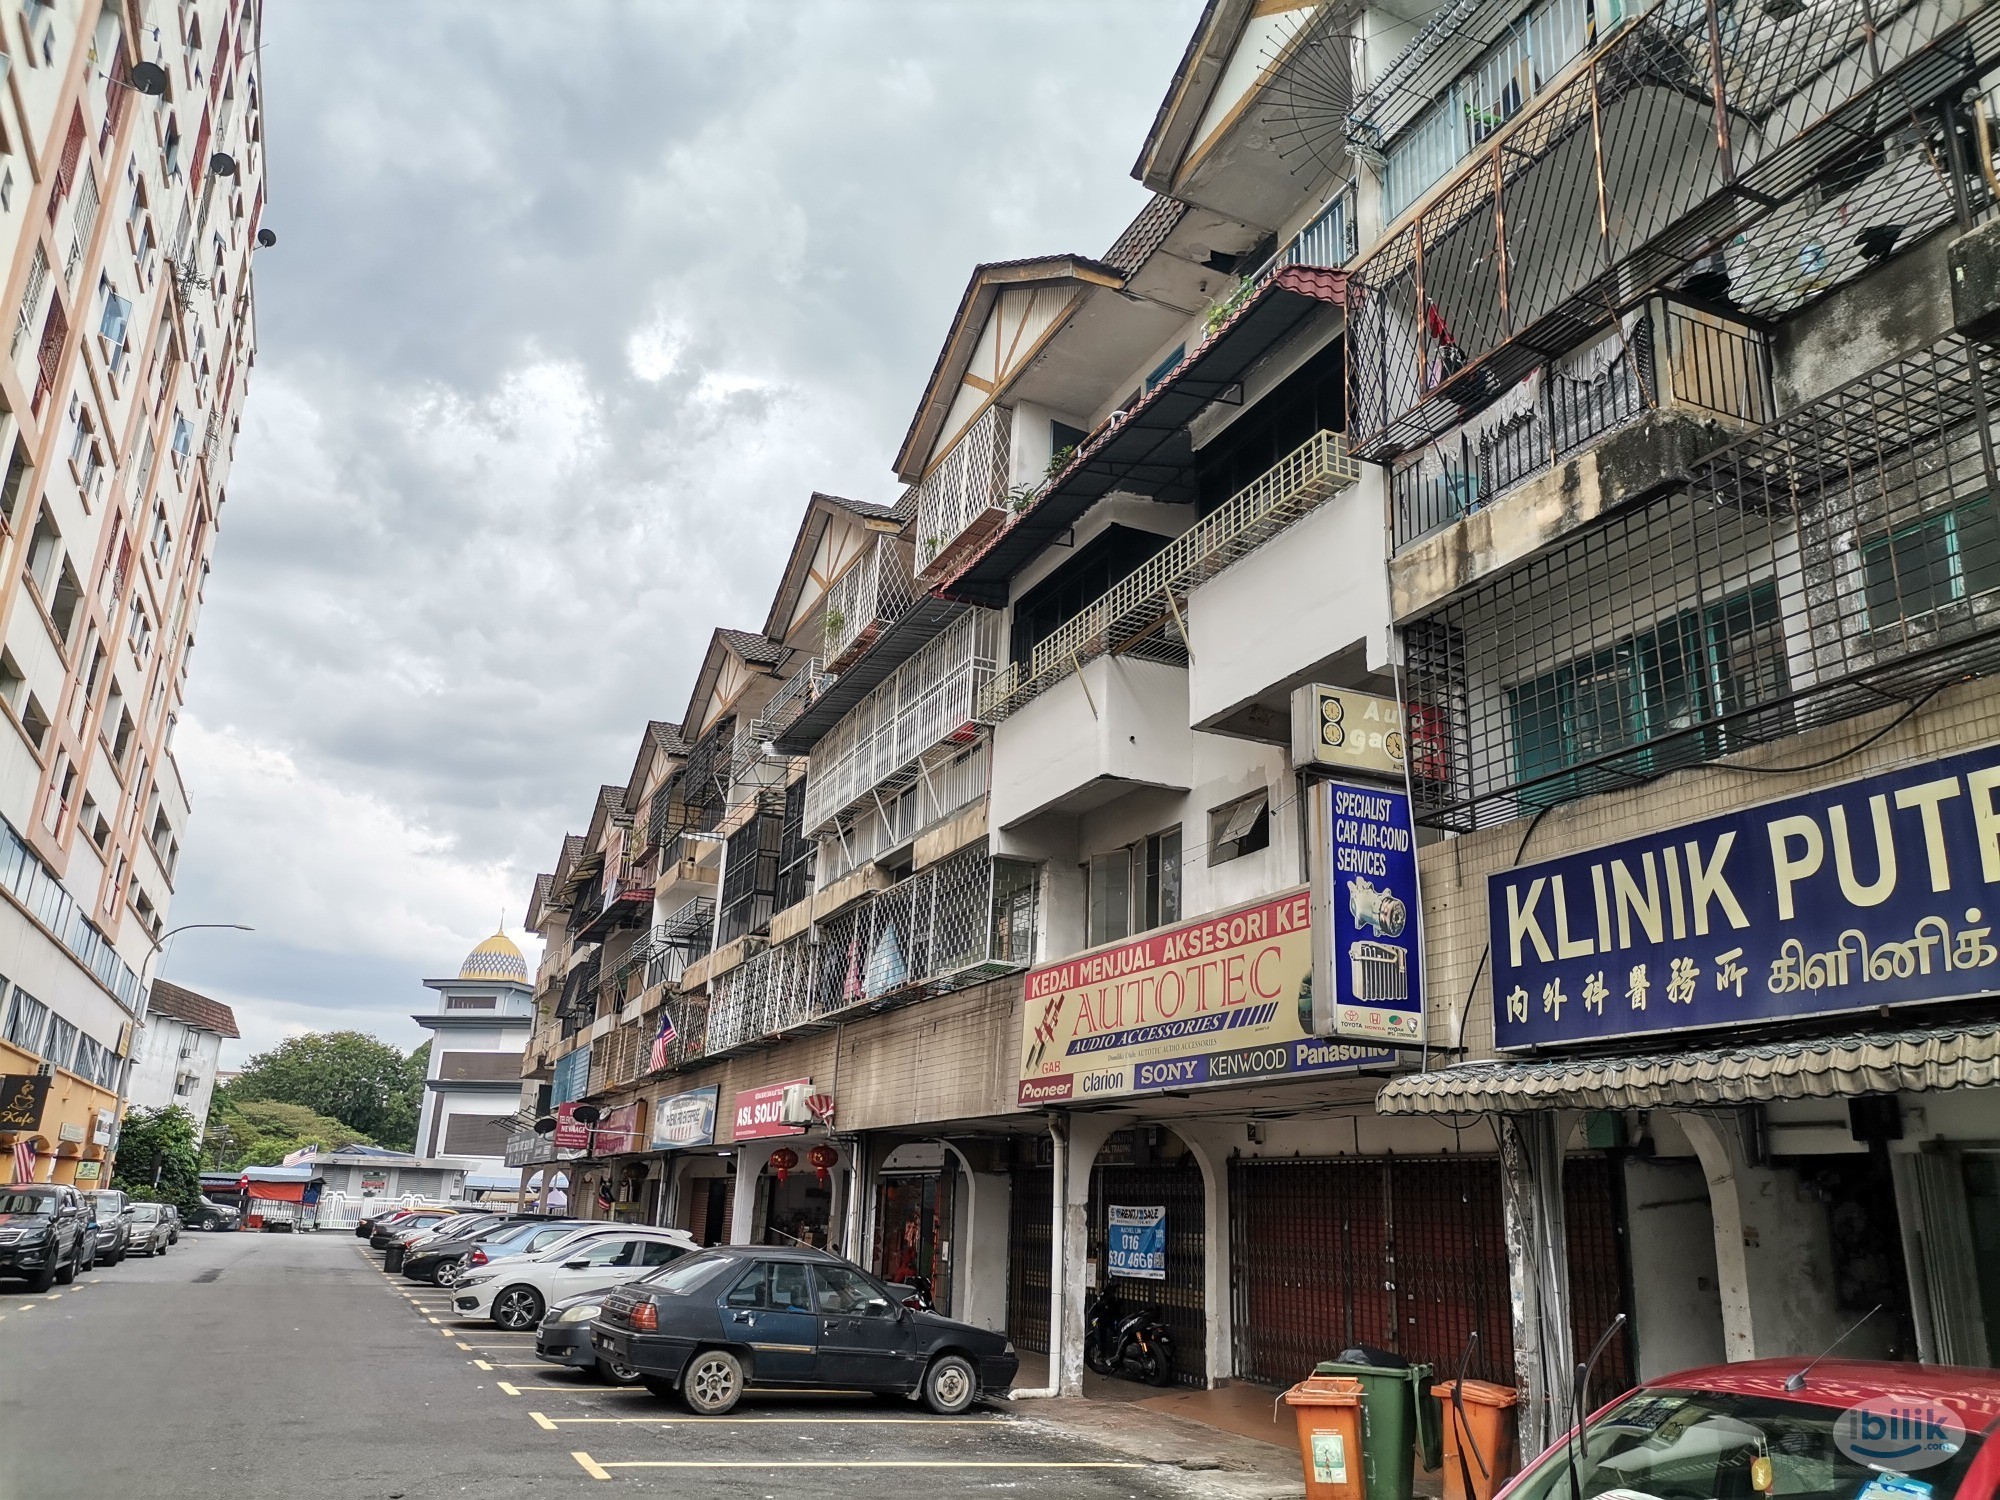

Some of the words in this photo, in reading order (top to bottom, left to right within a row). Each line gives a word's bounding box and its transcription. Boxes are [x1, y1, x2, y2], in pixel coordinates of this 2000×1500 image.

[1336, 791, 1392, 822] SPECIALIST
[1336, 818, 1357, 844] CAR
[1360, 822, 1409, 852] AIR-COND
[1337, 847, 1386, 876] SERVICES
[1506, 831, 1750, 967] KLINIK
[1031, 966, 1074, 998] KEDAI
[1079, 944, 1155, 986] MENJUAL
[1163, 910, 1267, 963] AKSESORI
[1276, 898, 1310, 933] KE
[1767, 907, 1998, 994] கிளினிக்
[1072, 946, 1282, 1036] AUTOTEC
[1071, 1034, 1115, 1054] AUDIO
[1117, 1014, 1222, 1046] ACCESSORIES
[1341, 1021, 1363, 1029] TOYOTA
[1141, 1061, 1198, 1084] SONY
[1209, 1048, 1287, 1077] KENWOOD
[1021, 1083, 1071, 1099] Pioneer
[1, 1111, 35, 1126] Kafe
[736, 1106, 752, 1127] ASL
[1122, 1235, 1140, 1250] 016
[1128, 1252, 1153, 1268] 4666
